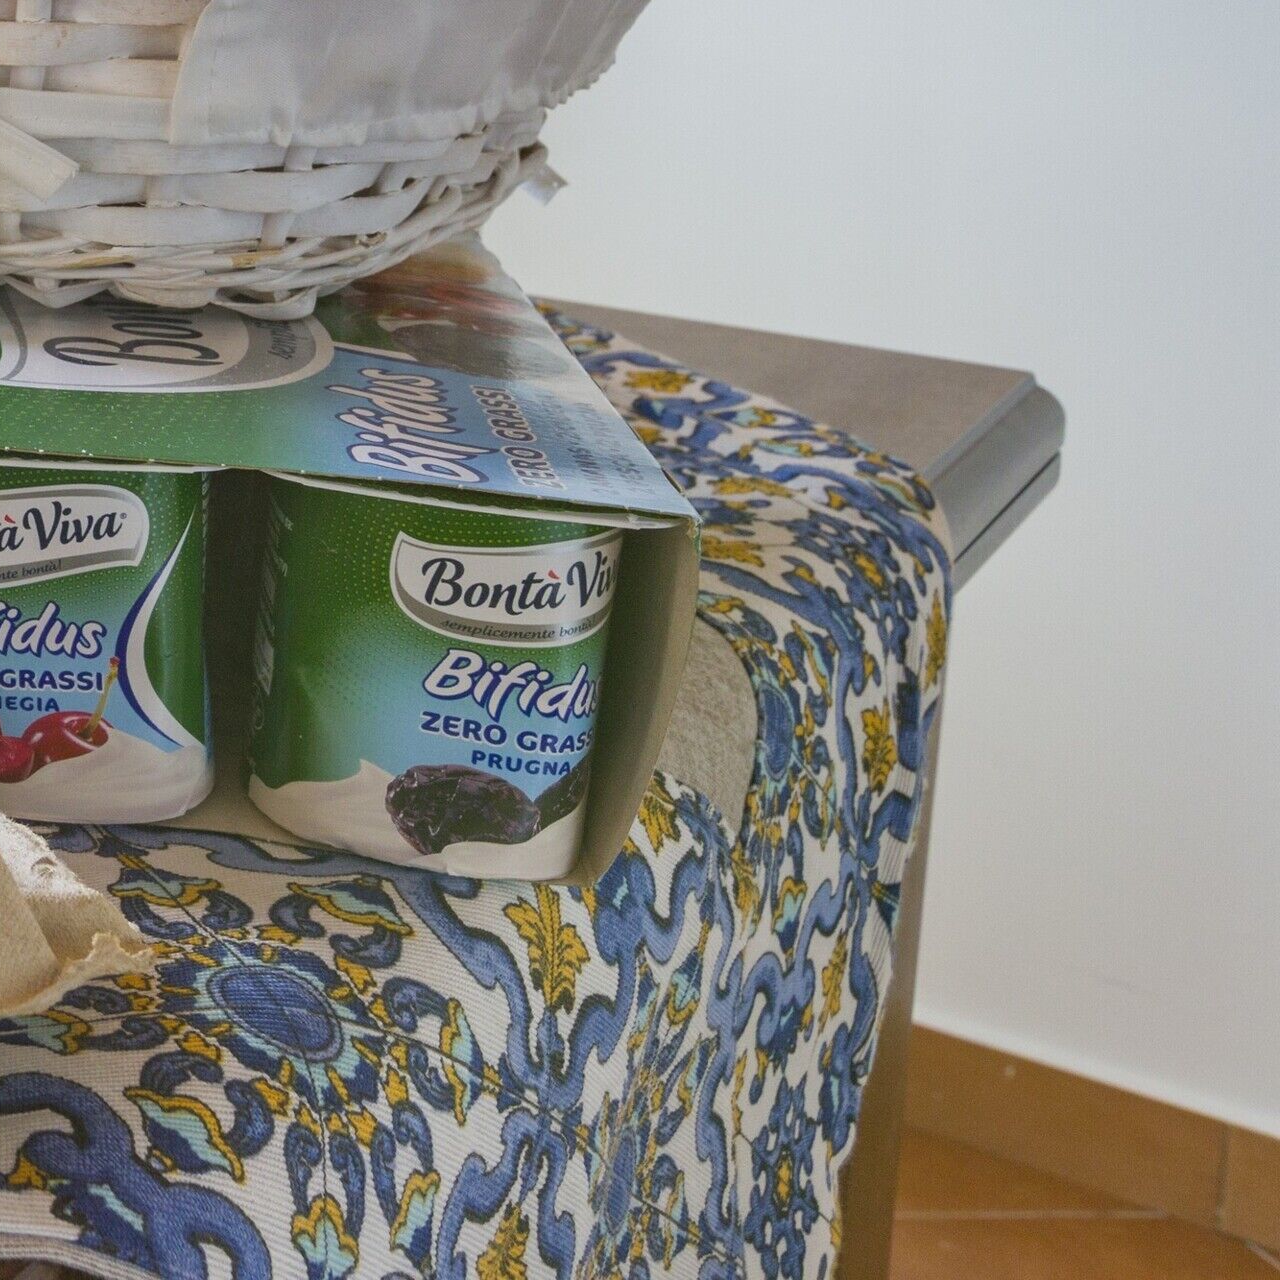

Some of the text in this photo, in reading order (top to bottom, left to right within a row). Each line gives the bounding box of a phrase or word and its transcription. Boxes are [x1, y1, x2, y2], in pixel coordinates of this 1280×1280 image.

[324, 367, 500, 484] Bifidus
[470, 384, 538, 444] GRASSI
[500, 444, 568, 491] ZERO
[22, 501, 124, 551] Viva
[421, 557, 567, 616] Bontà
[420, 710, 507, 746] ZERO
[471, 749, 572, 776] PRUGNA
